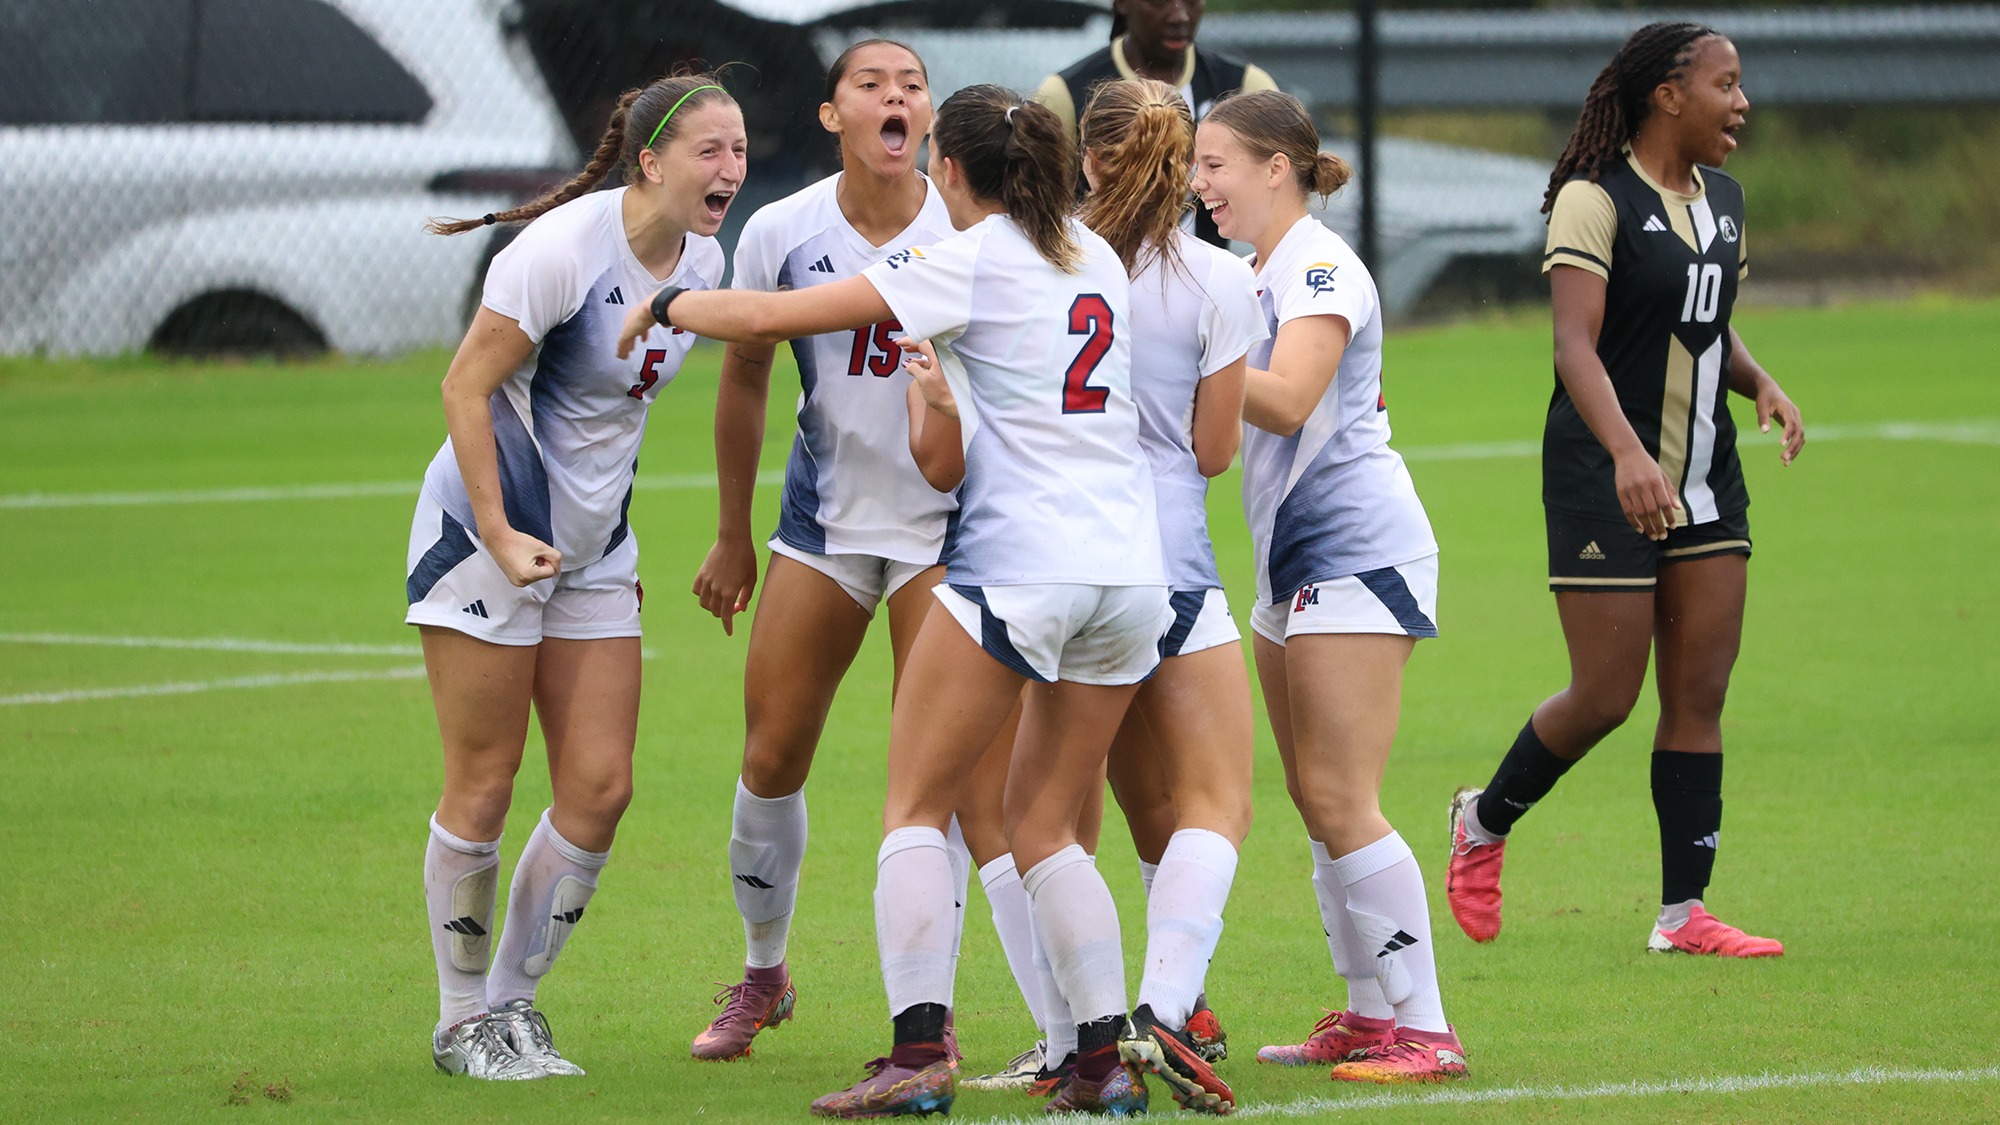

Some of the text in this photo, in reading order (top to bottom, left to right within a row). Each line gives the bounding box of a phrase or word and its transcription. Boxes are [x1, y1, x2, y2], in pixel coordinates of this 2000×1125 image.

[1681, 263, 1722, 322] 10
[627, 349, 667, 400] 5
[847, 319, 903, 378] 15
[1062, 293, 1114, 414] 2
[1579, 552, 1606, 560] adidas
